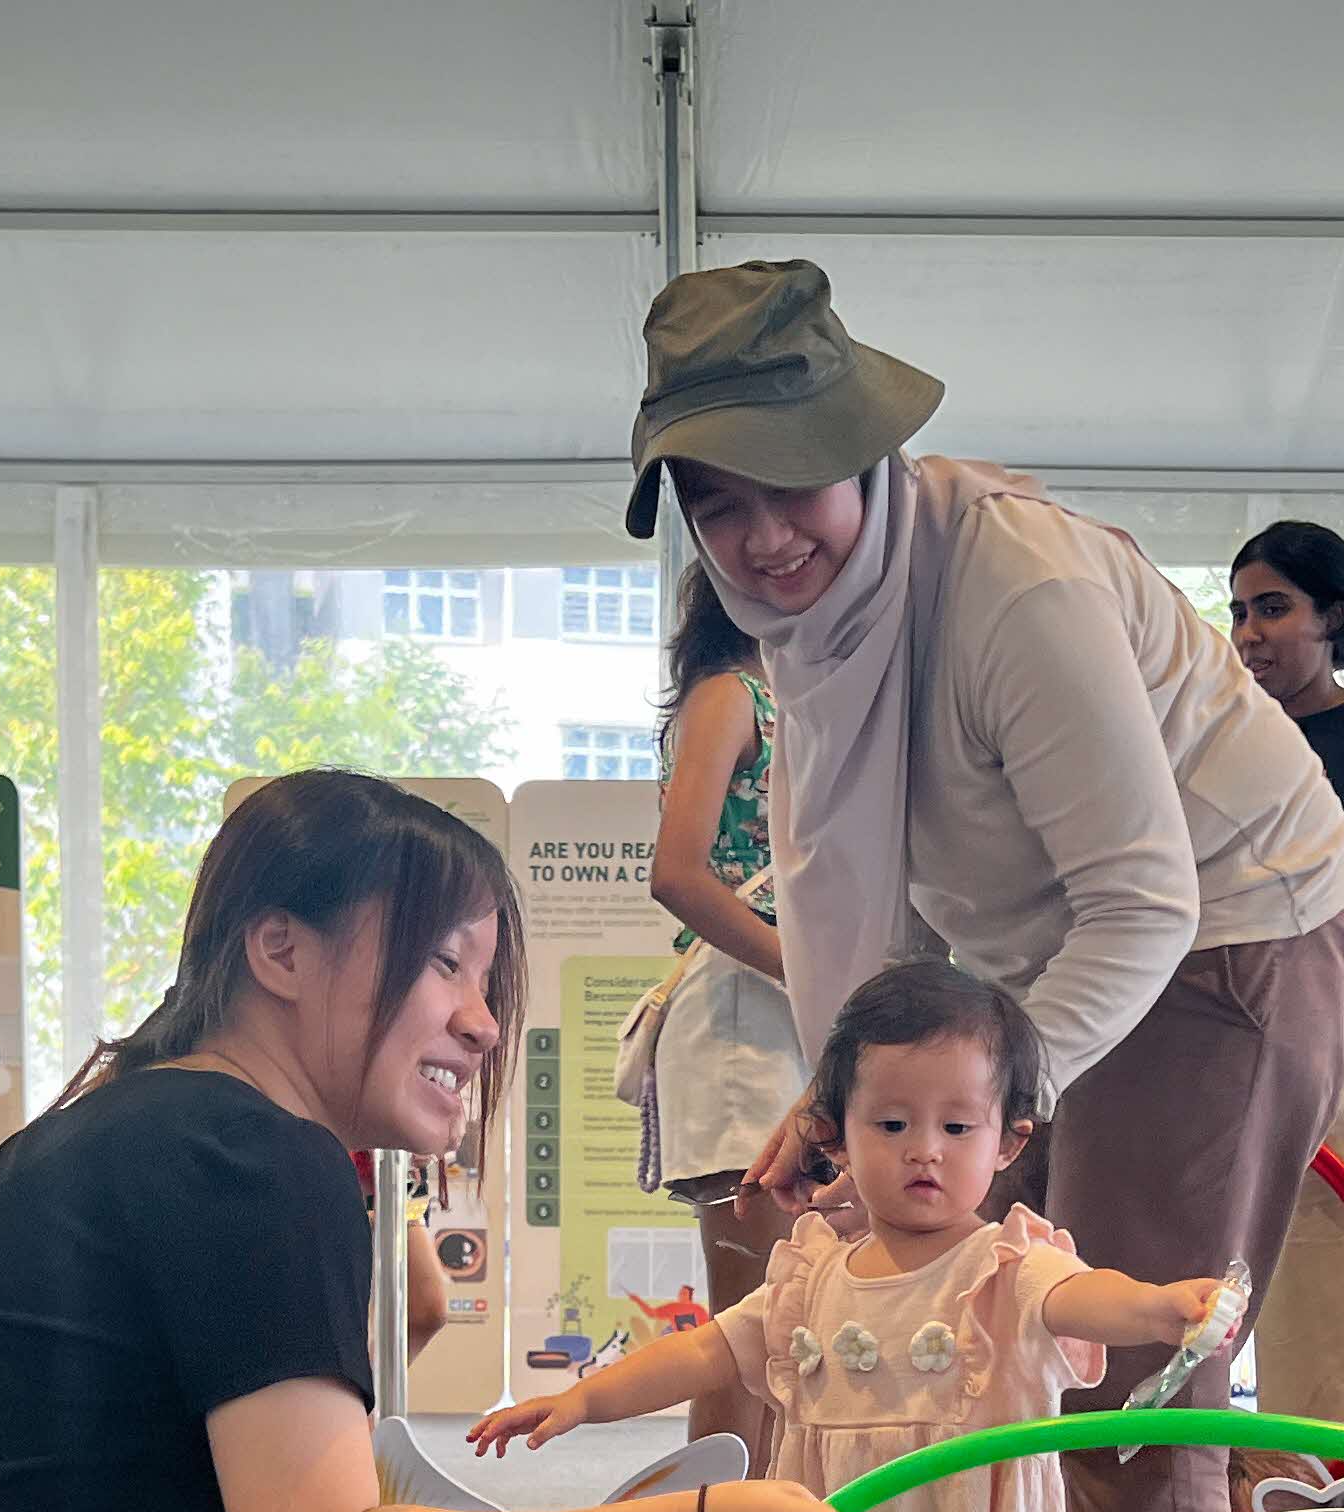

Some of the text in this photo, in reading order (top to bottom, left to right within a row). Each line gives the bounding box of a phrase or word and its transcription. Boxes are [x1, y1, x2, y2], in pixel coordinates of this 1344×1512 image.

[529, 842, 568, 859] ARE
[574, 842, 614, 859] YOU
[529, 866, 554, 881] TO
[561, 866, 609, 881] OWN
[616, 866, 628, 881] A
[540, 1037, 547, 1049] 1
[540, 1076, 548, 1088] 2
[540, 1115, 548, 1127] 3
[539, 1146, 548, 1157] 4
